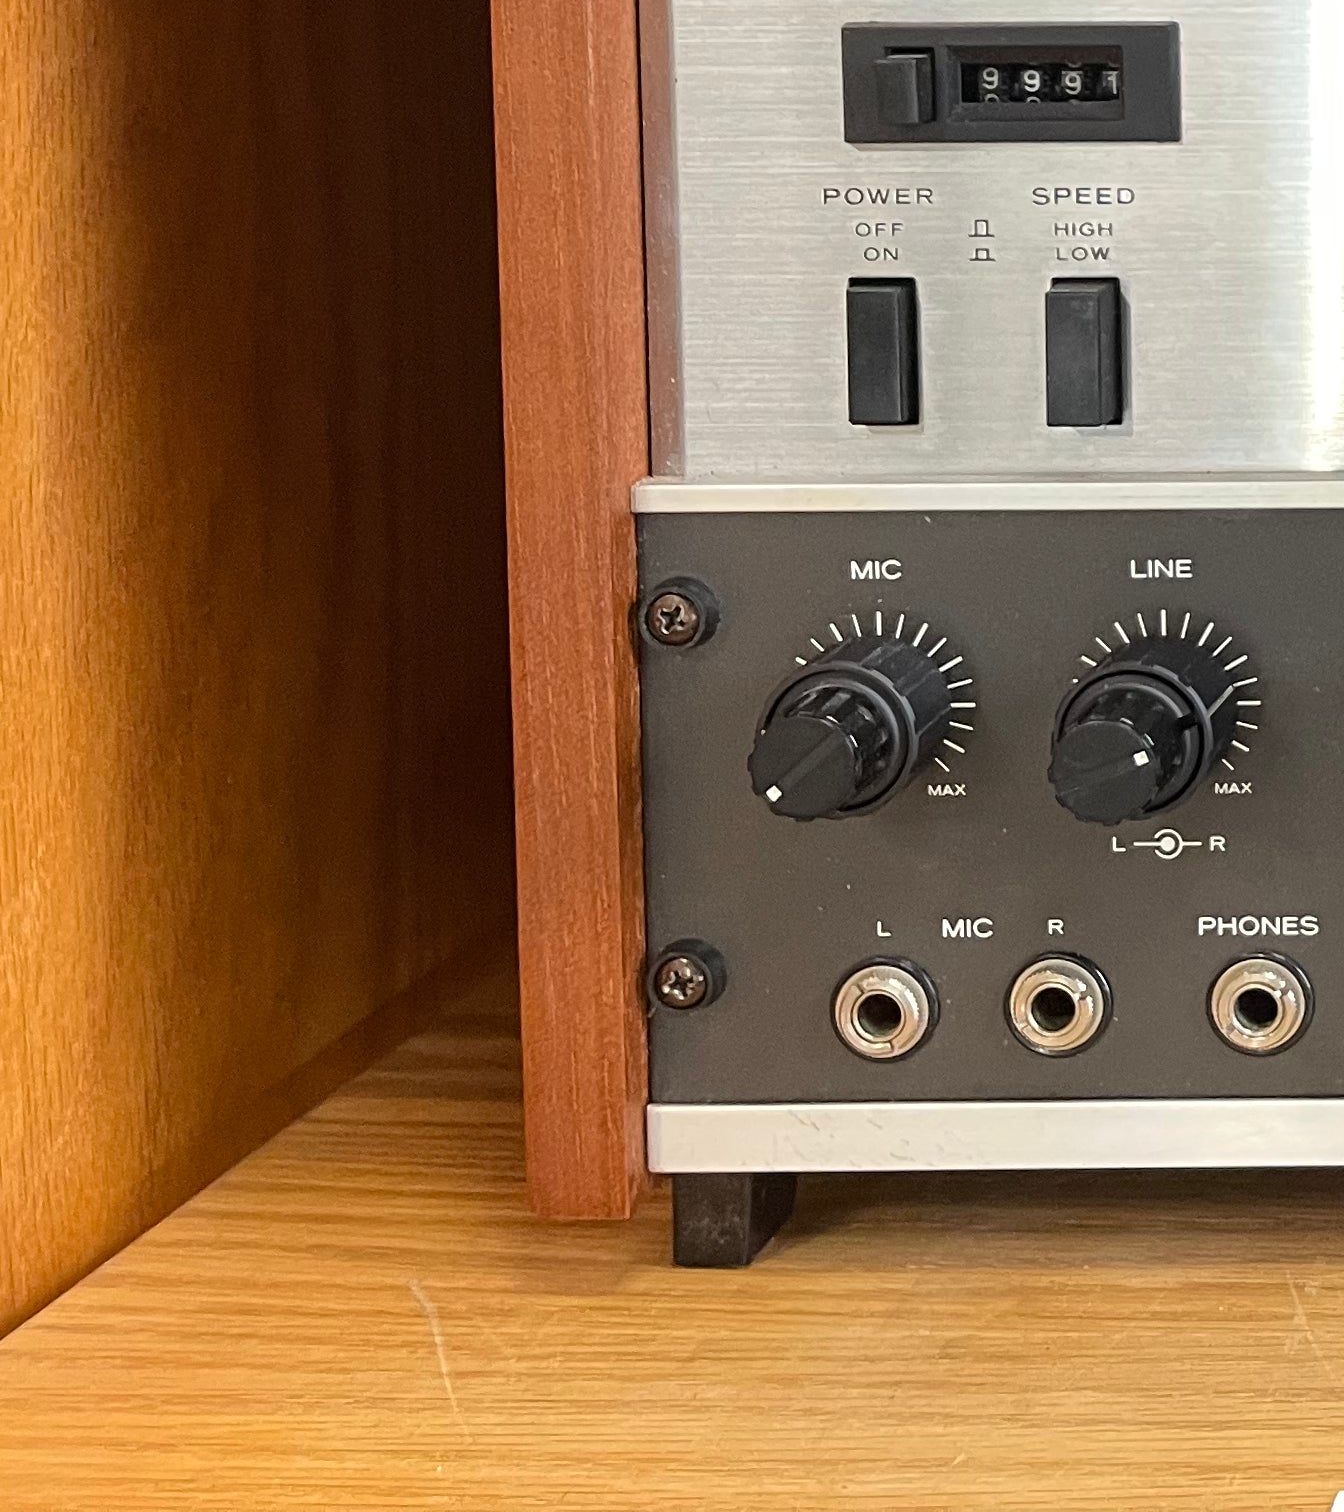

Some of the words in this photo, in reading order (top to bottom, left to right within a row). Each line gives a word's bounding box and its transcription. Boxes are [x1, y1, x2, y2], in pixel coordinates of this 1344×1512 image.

[823, 187, 933, 206] POWER
[1032, 186, 1135, 206] SPEED
[855, 222, 903, 238] OFF
[1054, 221, 1113, 237] HIGH
[863, 246, 899, 262] ON
[1056, 246, 1110, 262] LOW
[850, 559, 902, 580] MIC
[1130, 558, 1193, 579] LINE
[927, 783, 967, 796] MAX
[1214, 782, 1253, 795] MAX
[1111, 836, 1127, 853] L
[1209, 835, 1226, 852] R
[876, 920, 892, 937] L
[941, 917, 994, 939] MIC
[1047, 918, 1064, 935] R
[1198, 915, 1320, 937] PHONES
